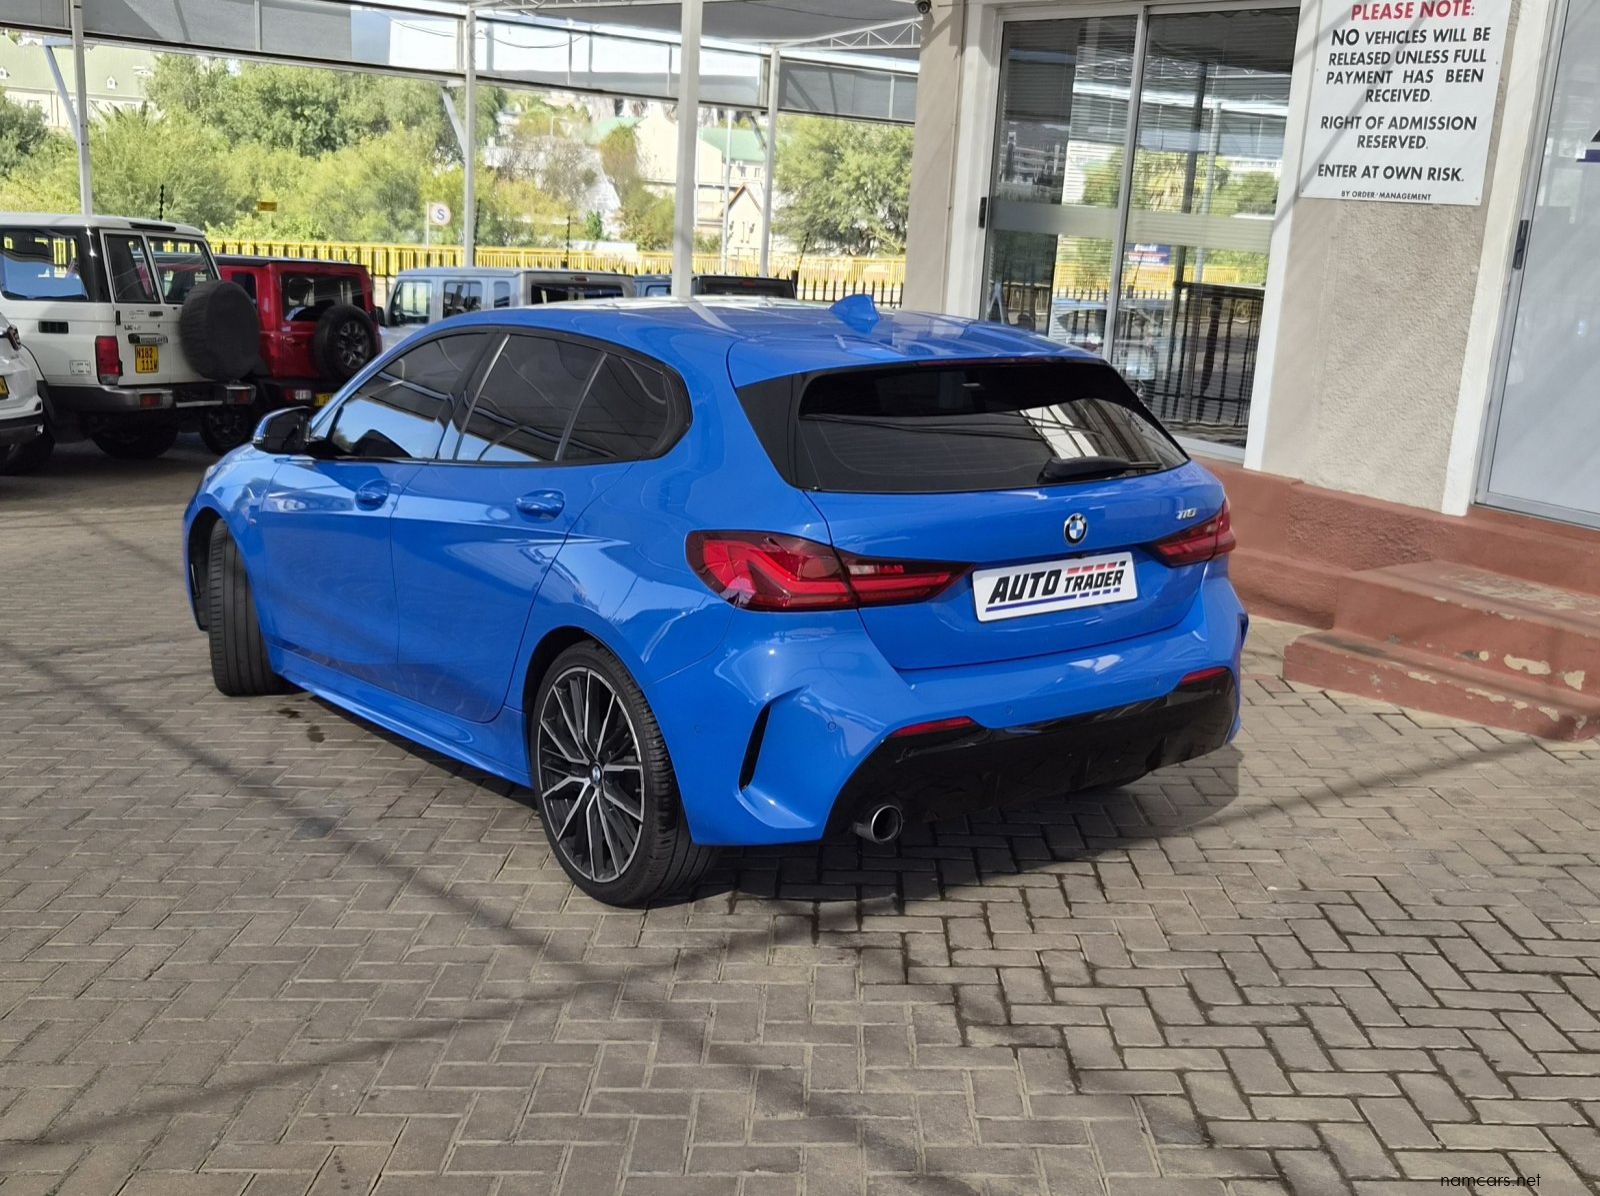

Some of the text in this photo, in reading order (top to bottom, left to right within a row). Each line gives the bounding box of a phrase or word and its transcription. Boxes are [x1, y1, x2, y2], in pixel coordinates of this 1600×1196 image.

[1351, 0, 1475, 20] PLEASE NOTE:
[1332, 27, 1491, 45] NO VEHICLES WILL BE
[1328, 49, 1487, 65] RELEASED UNLESS FULL
[1326, 69, 1484, 84] PAYMENT HAS BEEN
[1365, 89, 1432, 102] RECEIVED.
[1321, 116, 1477, 130] RIGHT OF ADMISSION
[1357, 135, 1429, 149] RESERVED.
[1318, 164, 1464, 182] ENTER AT OWN RISK.
[1379, 192, 1431, 200] MANAGEMENT
[437, 208, 445, 221] S
[988, 569, 1124, 605] AUTO TRADER
